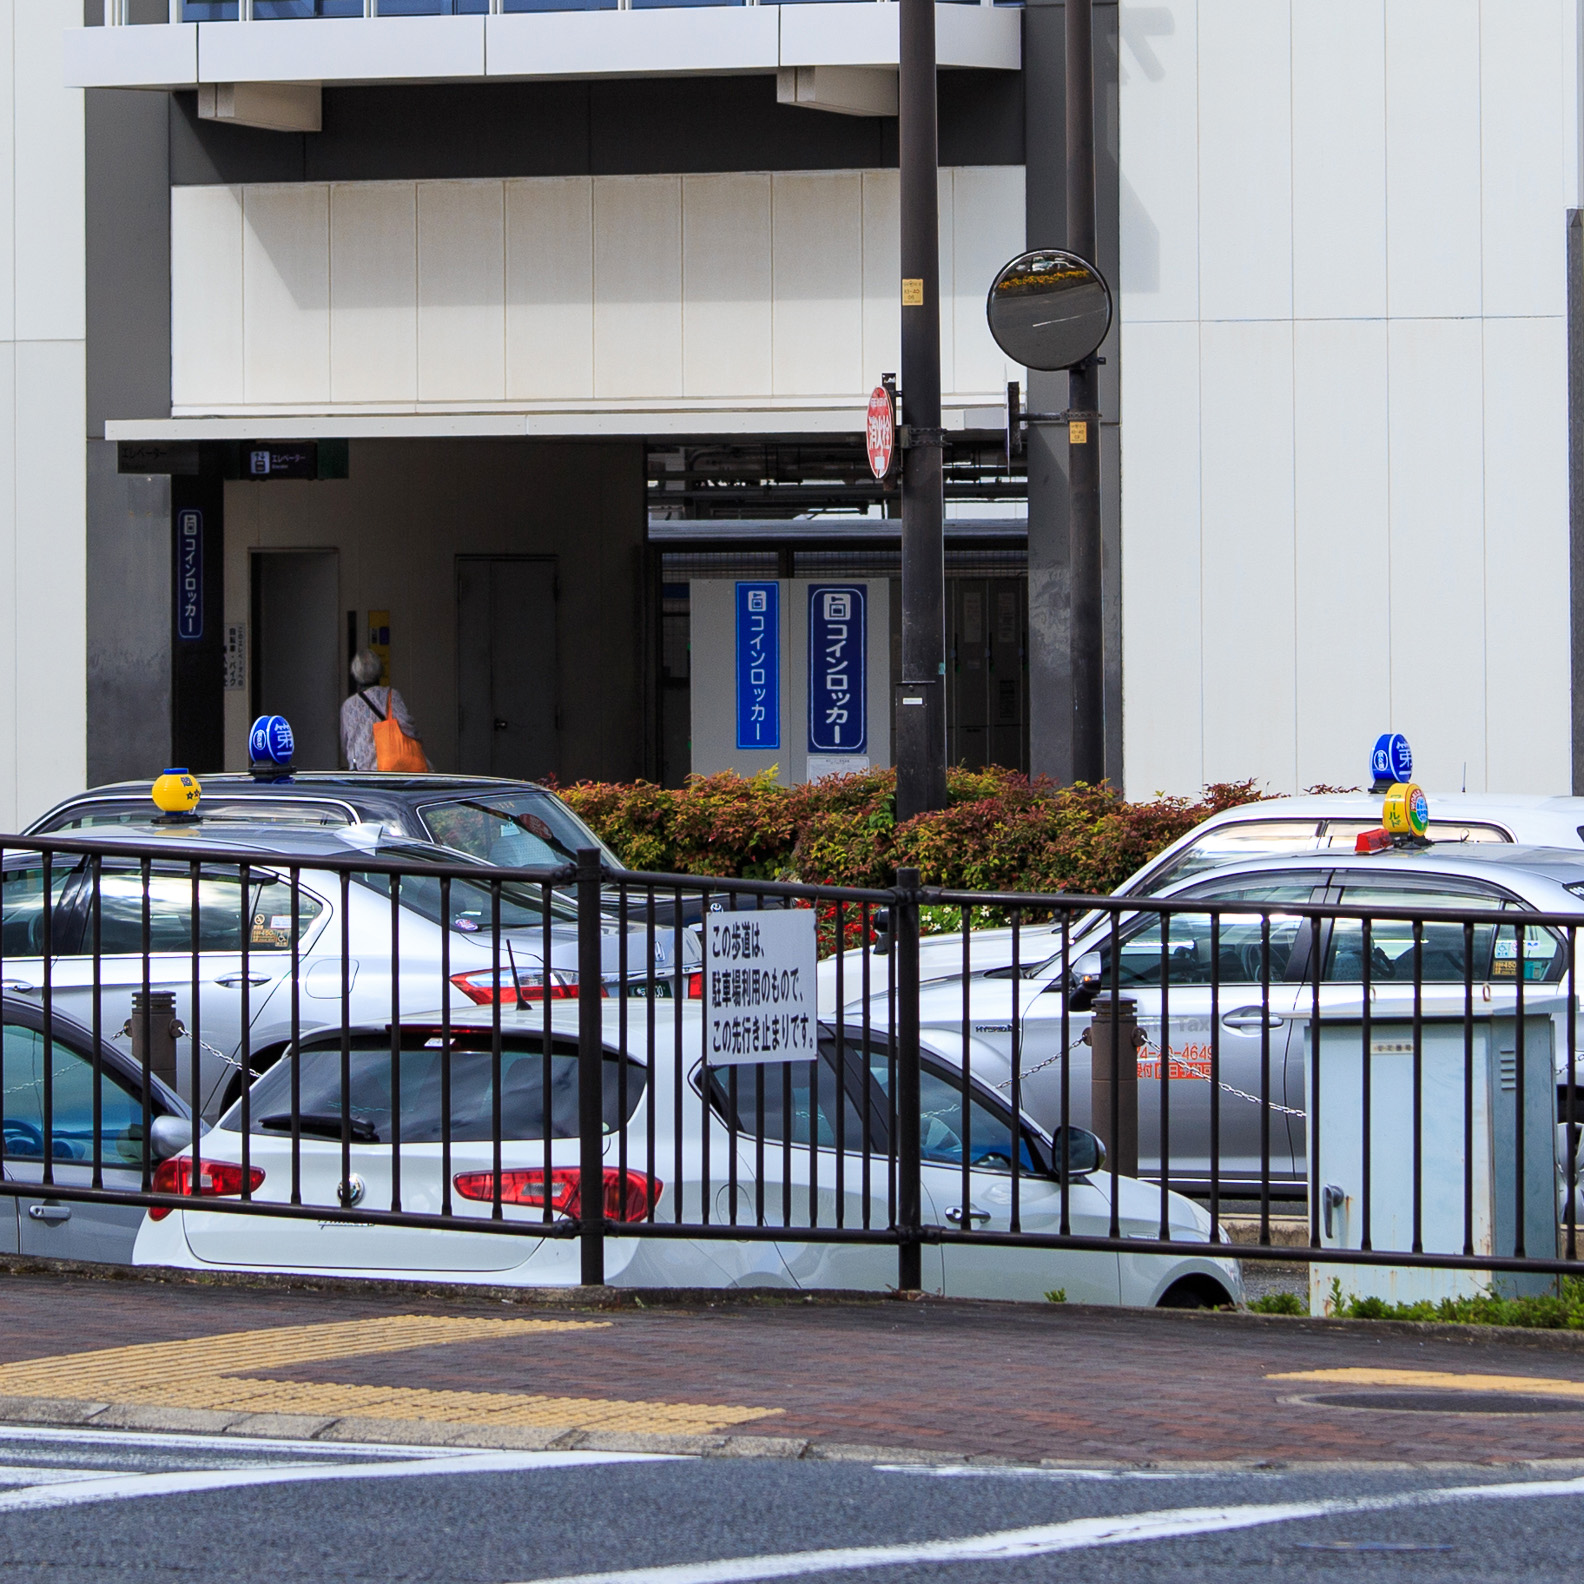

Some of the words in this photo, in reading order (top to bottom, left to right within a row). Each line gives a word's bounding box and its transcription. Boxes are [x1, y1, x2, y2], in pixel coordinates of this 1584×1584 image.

[185, 538, 196, 632] コインロッカー
[750, 616, 766, 741] コインロッカー
[825, 624, 849, 744] コインロッカー
[712, 921, 764, 959] この歩道は、
[712, 968, 803, 1008] 駐車場利用のもので、
[712, 1012, 813, 1054] この先行き止まりです。
